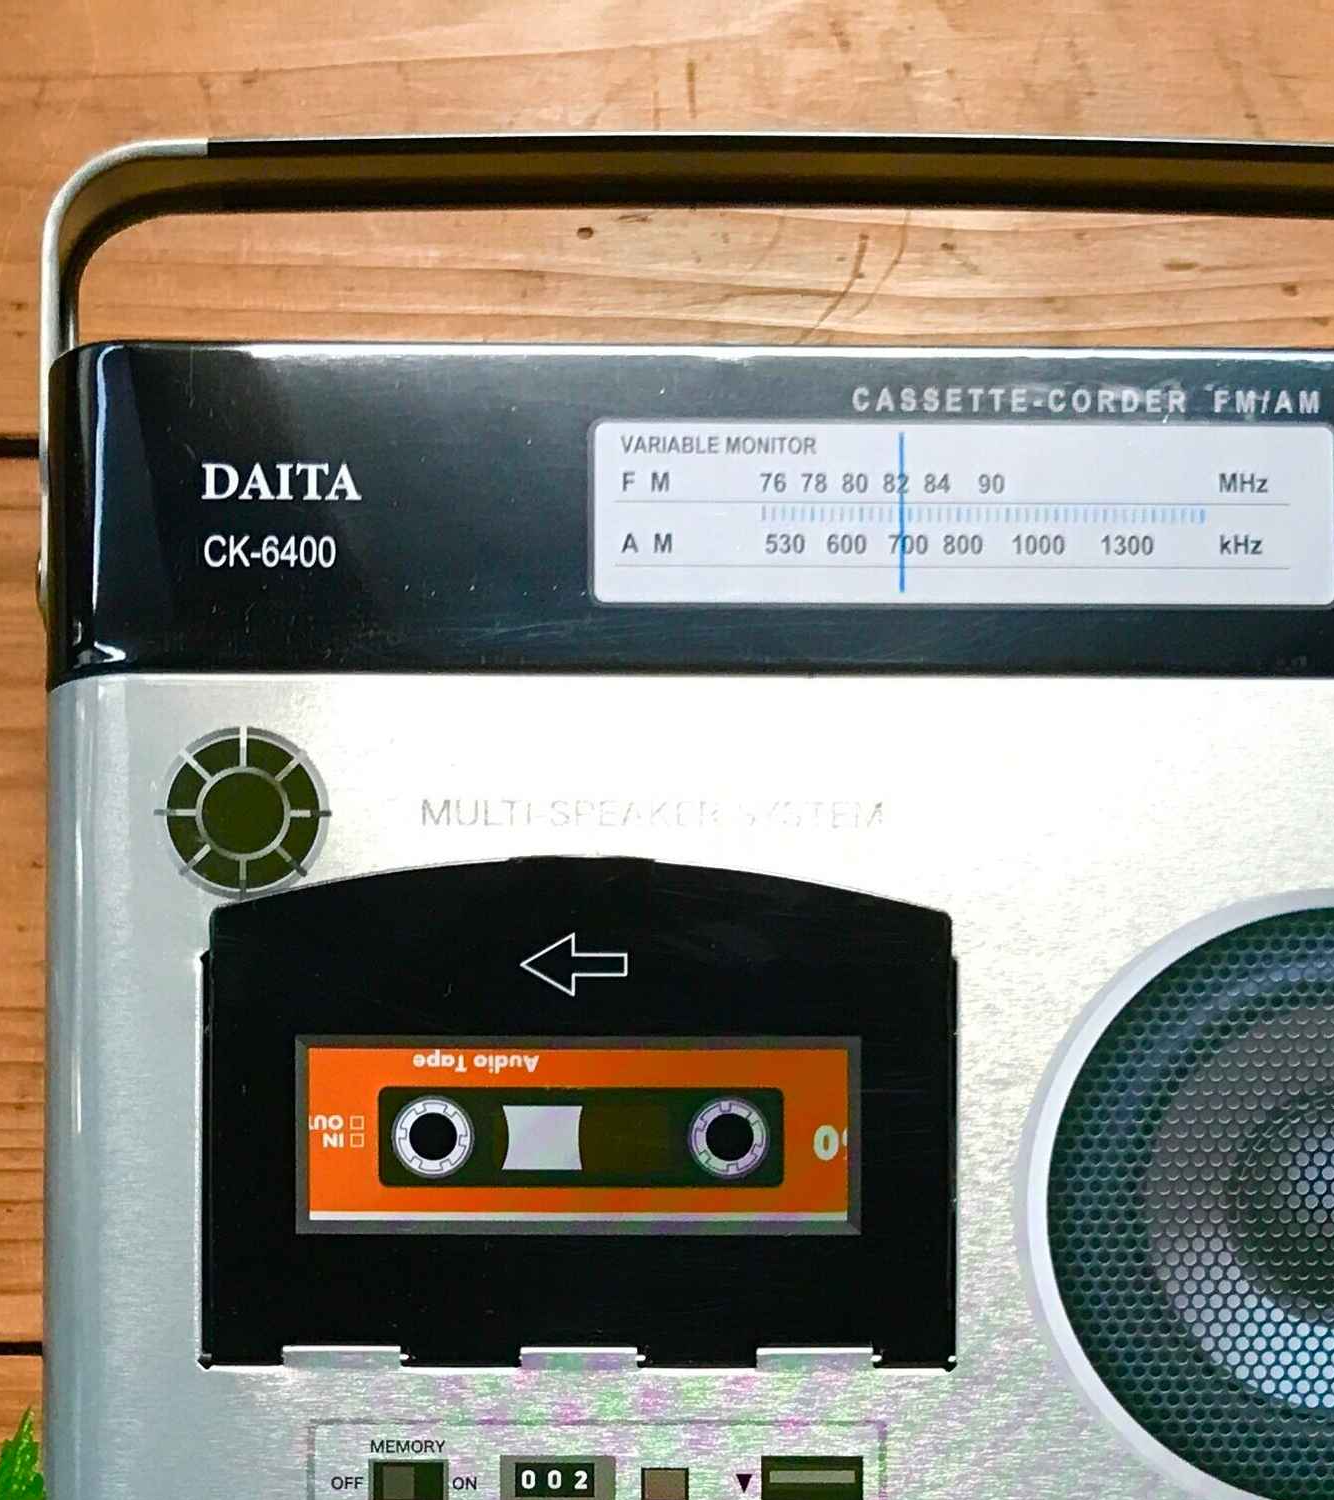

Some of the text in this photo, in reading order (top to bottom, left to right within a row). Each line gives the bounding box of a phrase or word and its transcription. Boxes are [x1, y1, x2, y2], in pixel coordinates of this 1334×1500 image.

[852, 387, 1321, 414] CASSETTE-CORDER FM/AM
[620, 436, 817, 455] VARIABLE MONITOR
[201, 463, 362, 501] DAITA
[760, 473, 787, 494] 76
[801, 473, 828, 494] 78
[841, 473, 868, 494] 80
[882, 473, 910, 494] 82
[923, 473, 951, 494] 84
[977, 473, 1006, 495] 90
[1218, 473, 1269, 494] MHz
[203, 535, 337, 569] CK-6400
[765, 534, 806, 554] 530
[825, 534, 867, 554] 600
[888, 534, 929, 555] 700
[942, 534, 984, 555] 800
[1011, 535, 1066, 555] 1000
[1100, 535, 1155, 556] 1300
[1219, 535, 1264, 555] kHz
[412, 1053, 540, 1073] Audio Tape
[322, 1132, 345, 1149] IN
[370, 1439, 446, 1454] MEMORY
[331, 1476, 478, 1491] OFF ON
